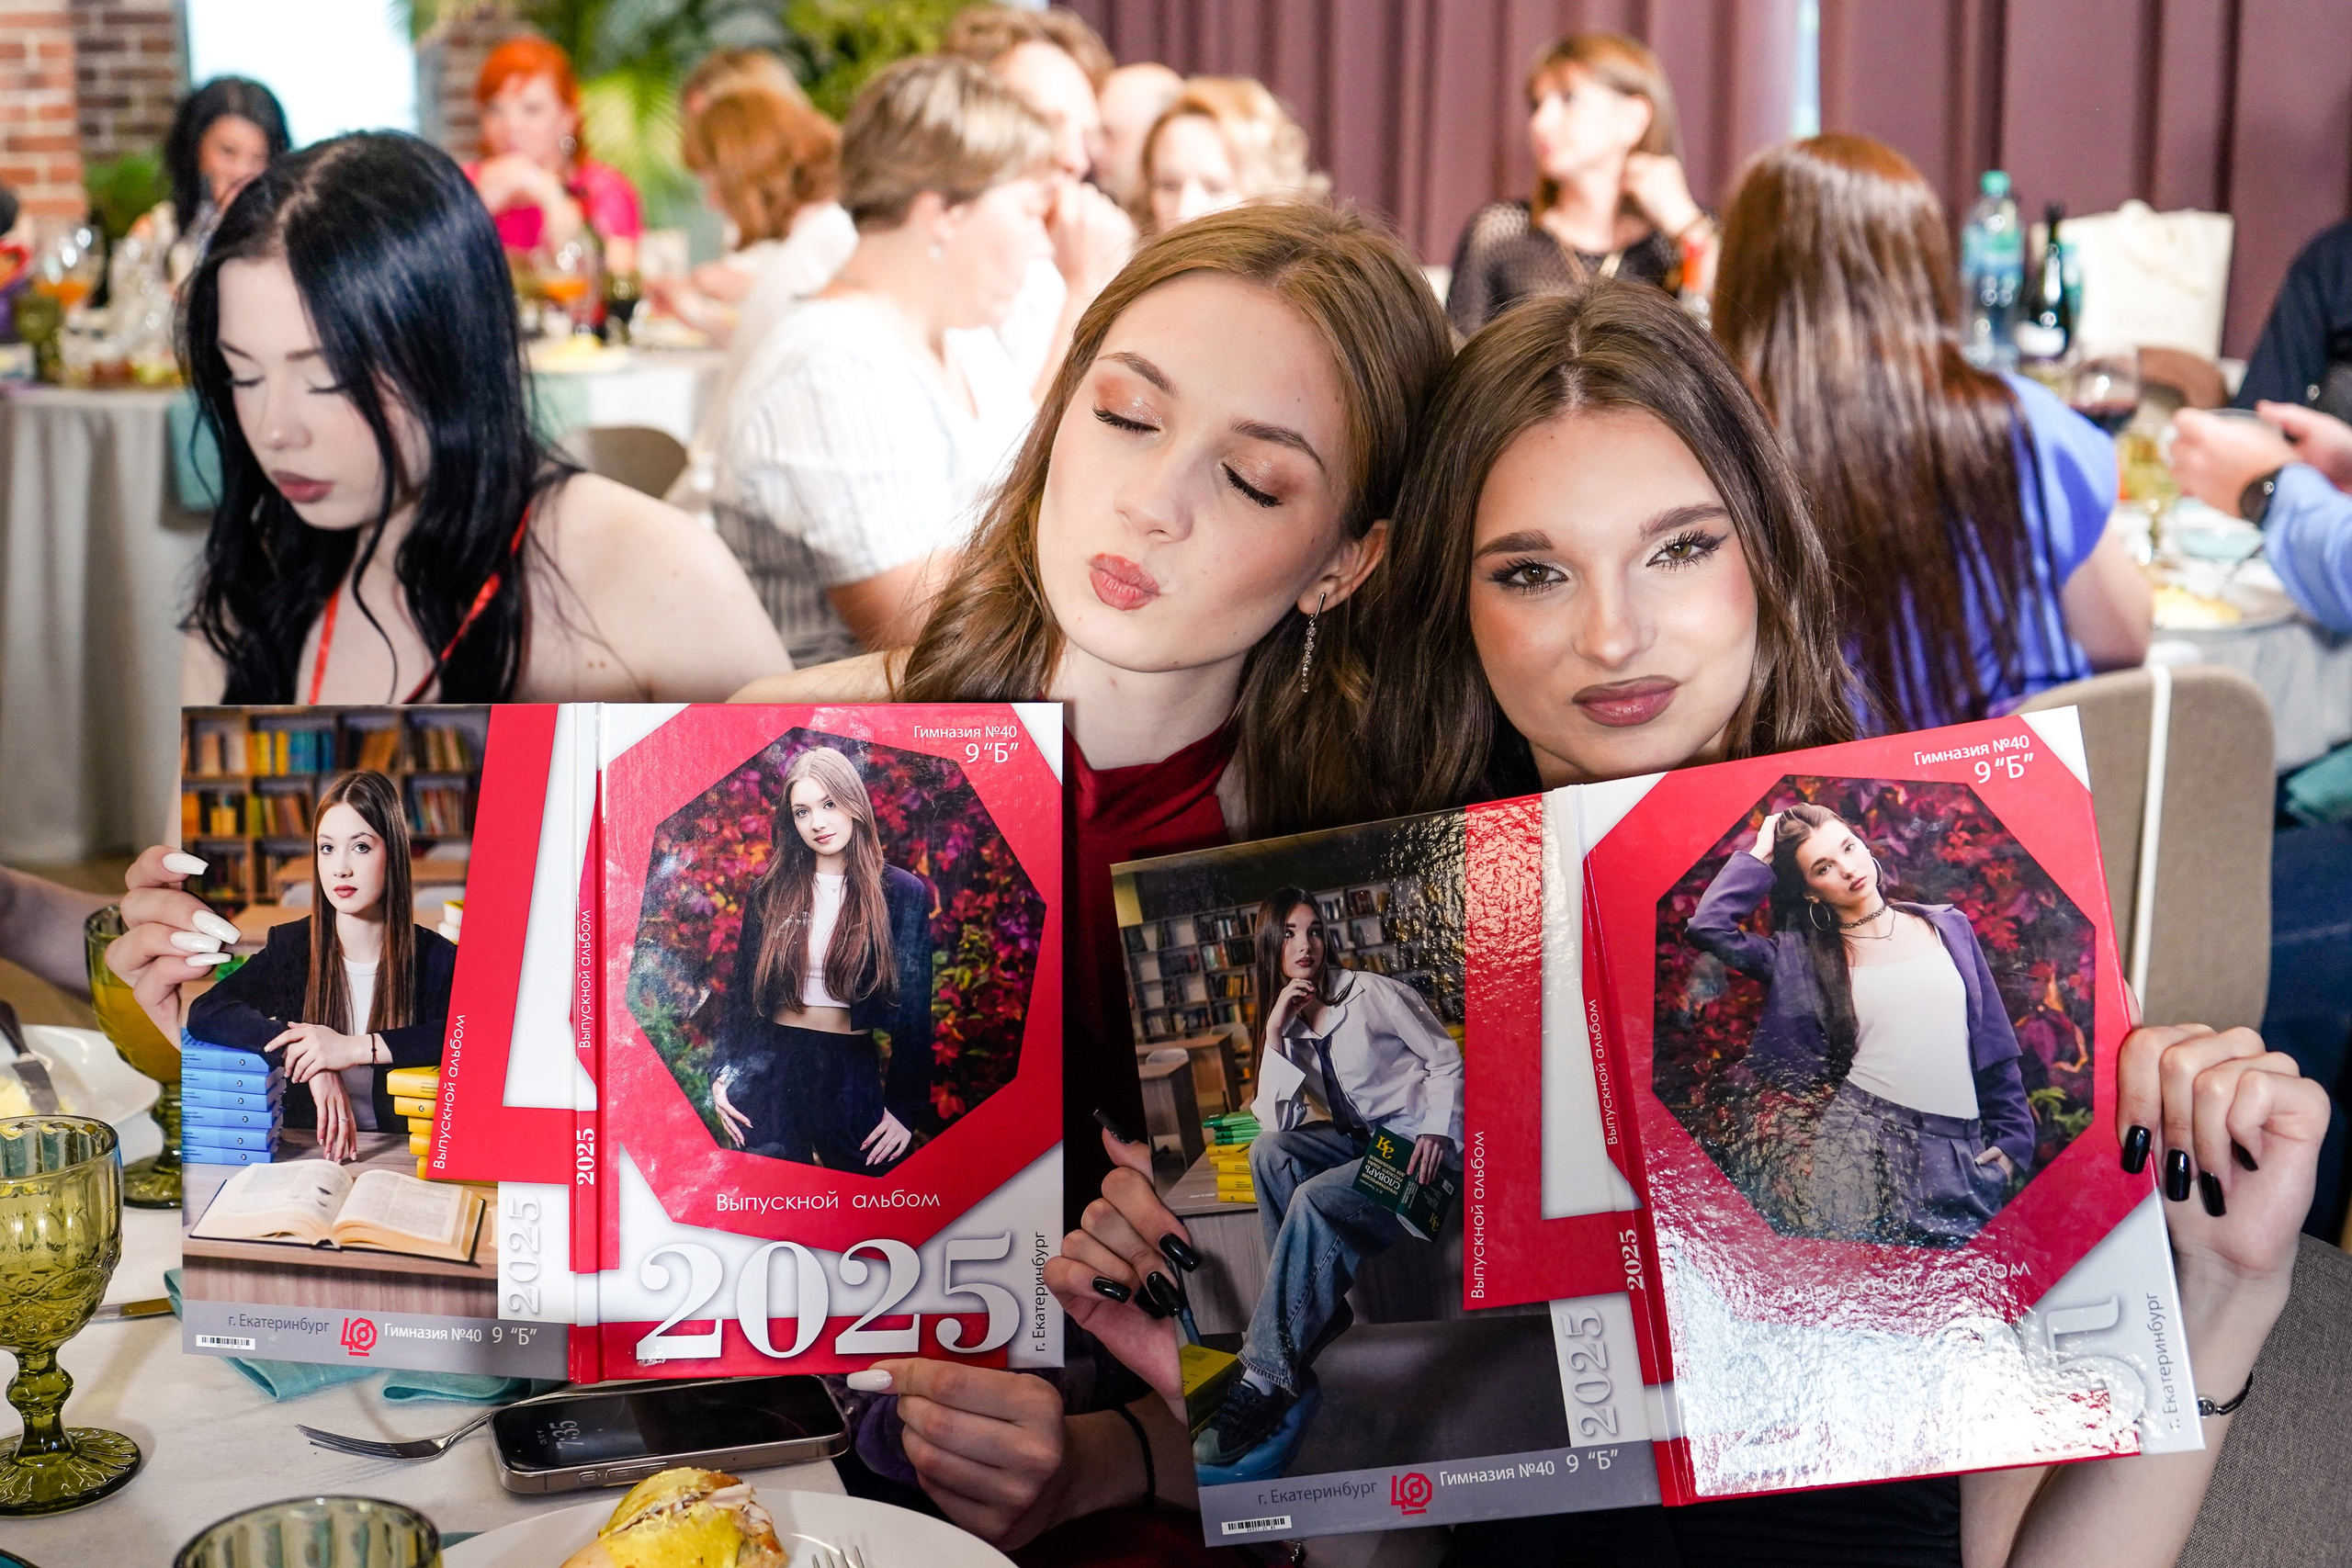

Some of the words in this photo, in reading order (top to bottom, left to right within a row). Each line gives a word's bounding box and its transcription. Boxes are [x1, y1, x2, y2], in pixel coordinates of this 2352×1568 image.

[913, 725, 981, 739] Гимназия
[985, 725, 1017, 739] №40
[965, 742, 979, 763] 9
[1914, 742, 1989, 766] Гимназия
[1992, 735, 2030, 752] №40
[1974, 761, 1991, 784] 9
[578, 909, 591, 966] альбом
[577, 969, 594, 1048] Выпускной
[1589, 999, 1605, 1059] альбом
[433, 1081, 457, 1169] Выпускной
[448, 1014, 466, 1077] альбом
[1595, 1063, 1618, 1145] Выпускной
[576, 1128, 594, 1186] 2025
[1364, 1165, 1401, 1190] СЛОВАРЬ
[1470, 1131, 1485, 1200] альбом
[716, 1190, 840, 1214] Выпускной
[853, 1191, 941, 1210] альбом
[505, 1193, 540, 1314] 2025
[1470, 1206, 1485, 1299] Выпускной
[1619, 1229, 1644, 1291] 2025
[636, 1231, 1021, 1360] 2025
[1032, 1232, 1049, 1338] Екатеринбург
[228, 1315, 236, 1326] г.
[239, 1314, 330, 1335] Екатеринбург
[384, 1323, 448, 1340] Гимназия
[451, 1327, 482, 1343] №40
[492, 1326, 503, 1344] 9
[1035, 1342, 1046, 1352] г.
[2146, 1292, 2178, 1415] Екатеринбург
[1561, 1308, 1619, 1436] 2025
[1258, 1494, 1268, 1505] г.
[1271, 1481, 1377, 1503] Екатеринбург
[1440, 1468, 1516, 1486] Гимназия
[1519, 1461, 1555, 1478] №40
[1566, 1454, 1579, 1473] 9
